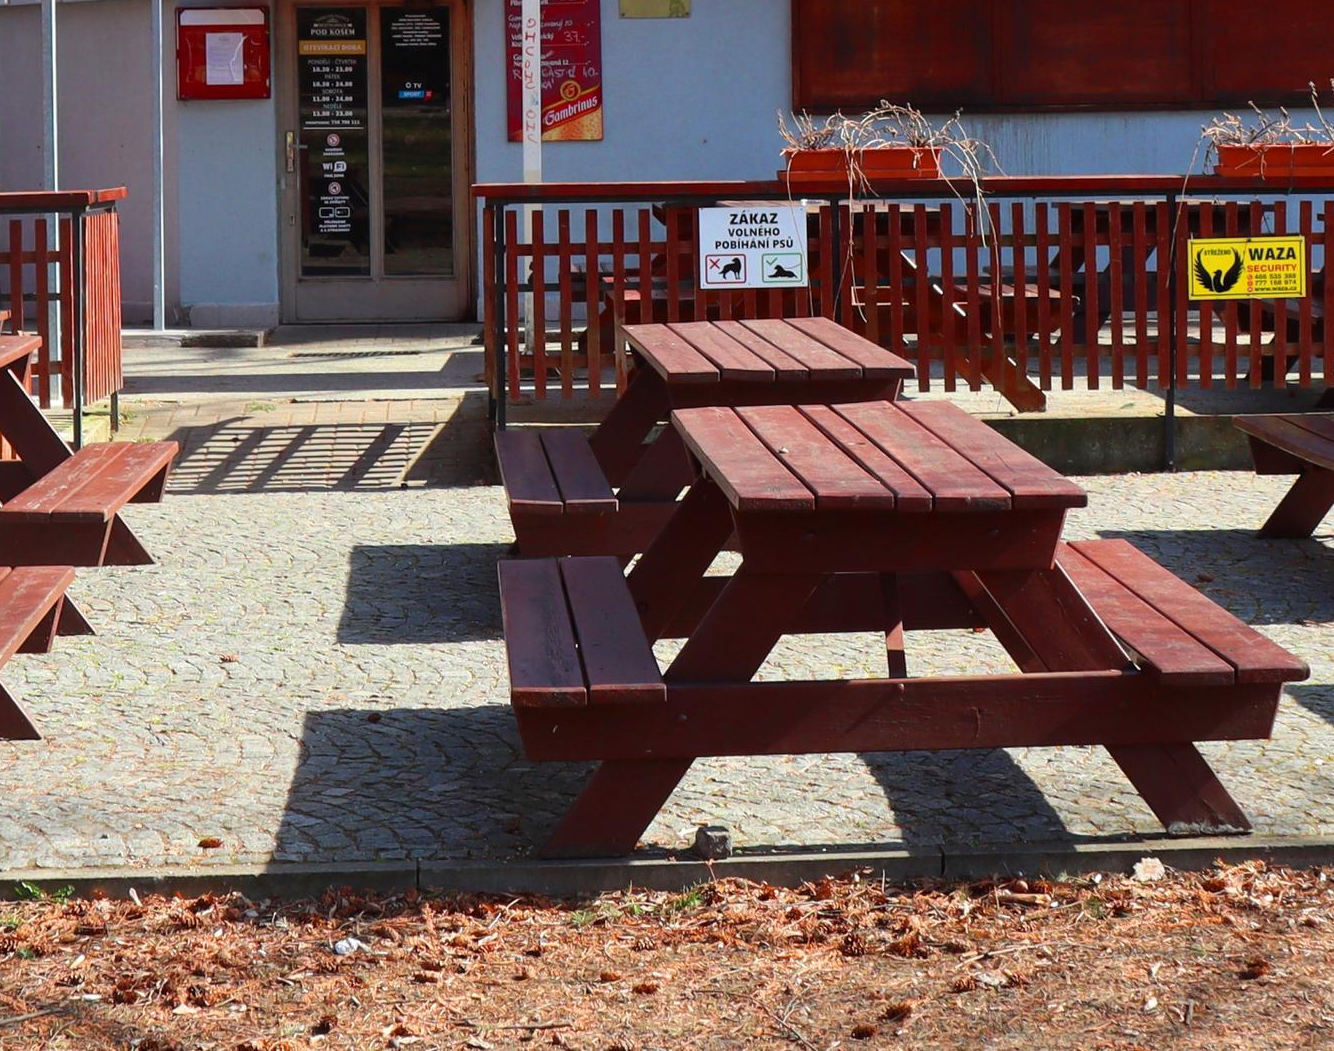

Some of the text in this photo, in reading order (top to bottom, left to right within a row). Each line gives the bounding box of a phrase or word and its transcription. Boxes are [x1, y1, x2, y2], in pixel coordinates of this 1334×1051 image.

[329, 27, 355, 35] KOŠEM
[544, 95, 598, 126] Gambrinus
[729, 210, 778, 225] ZÁKAZ
[728, 225, 780, 237] VOLNÉHO
[715, 236, 794, 249] POBÍHÁNÍ PSŮ
[1248, 247, 1296, 261] WAZA
[1247, 264, 1297, 273] SECURITY
